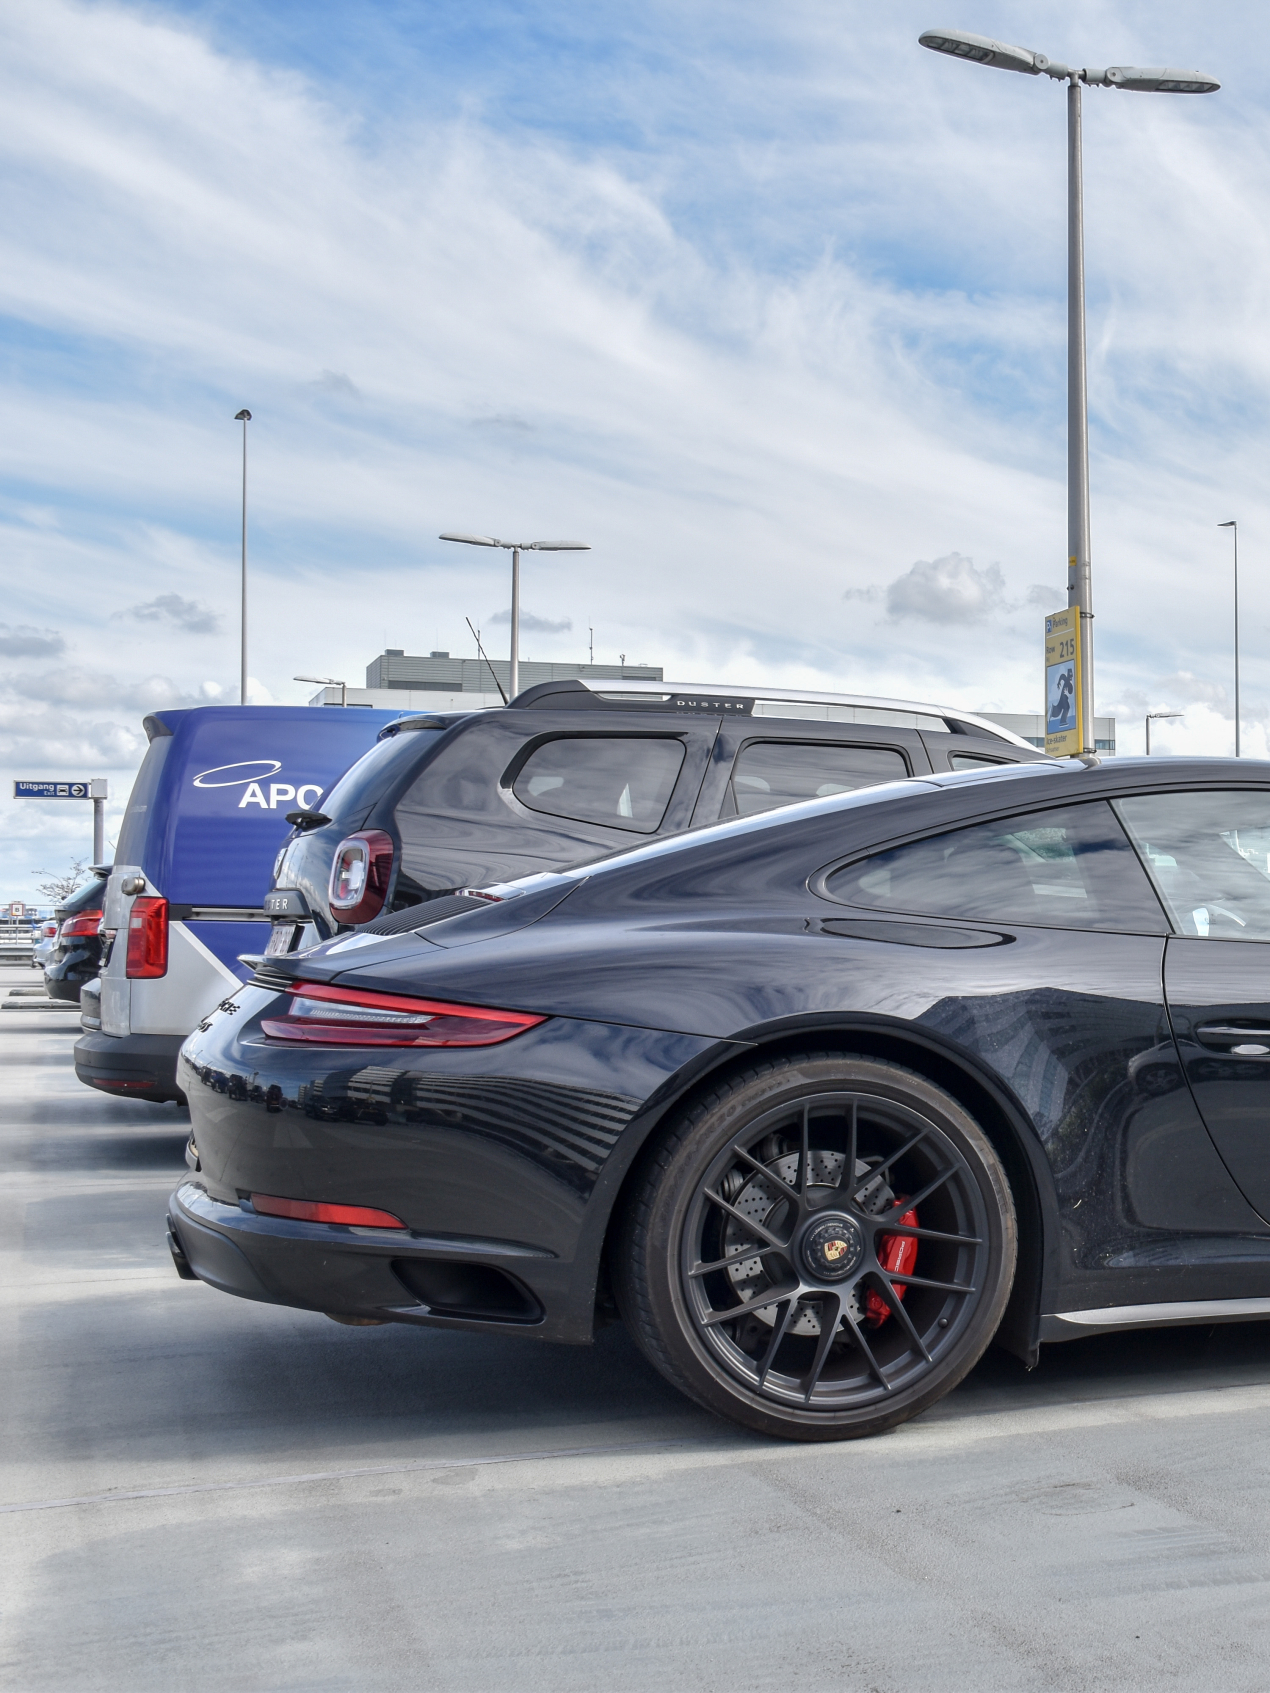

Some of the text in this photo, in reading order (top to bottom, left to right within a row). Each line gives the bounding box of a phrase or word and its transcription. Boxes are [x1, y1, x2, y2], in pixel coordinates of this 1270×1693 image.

[1060, 638, 1075, 658] 215
[676, 700, 744, 709] DUSTER
[19, 782, 55, 792] Uitgang
[894, 1240, 906, 1272] PORSC
